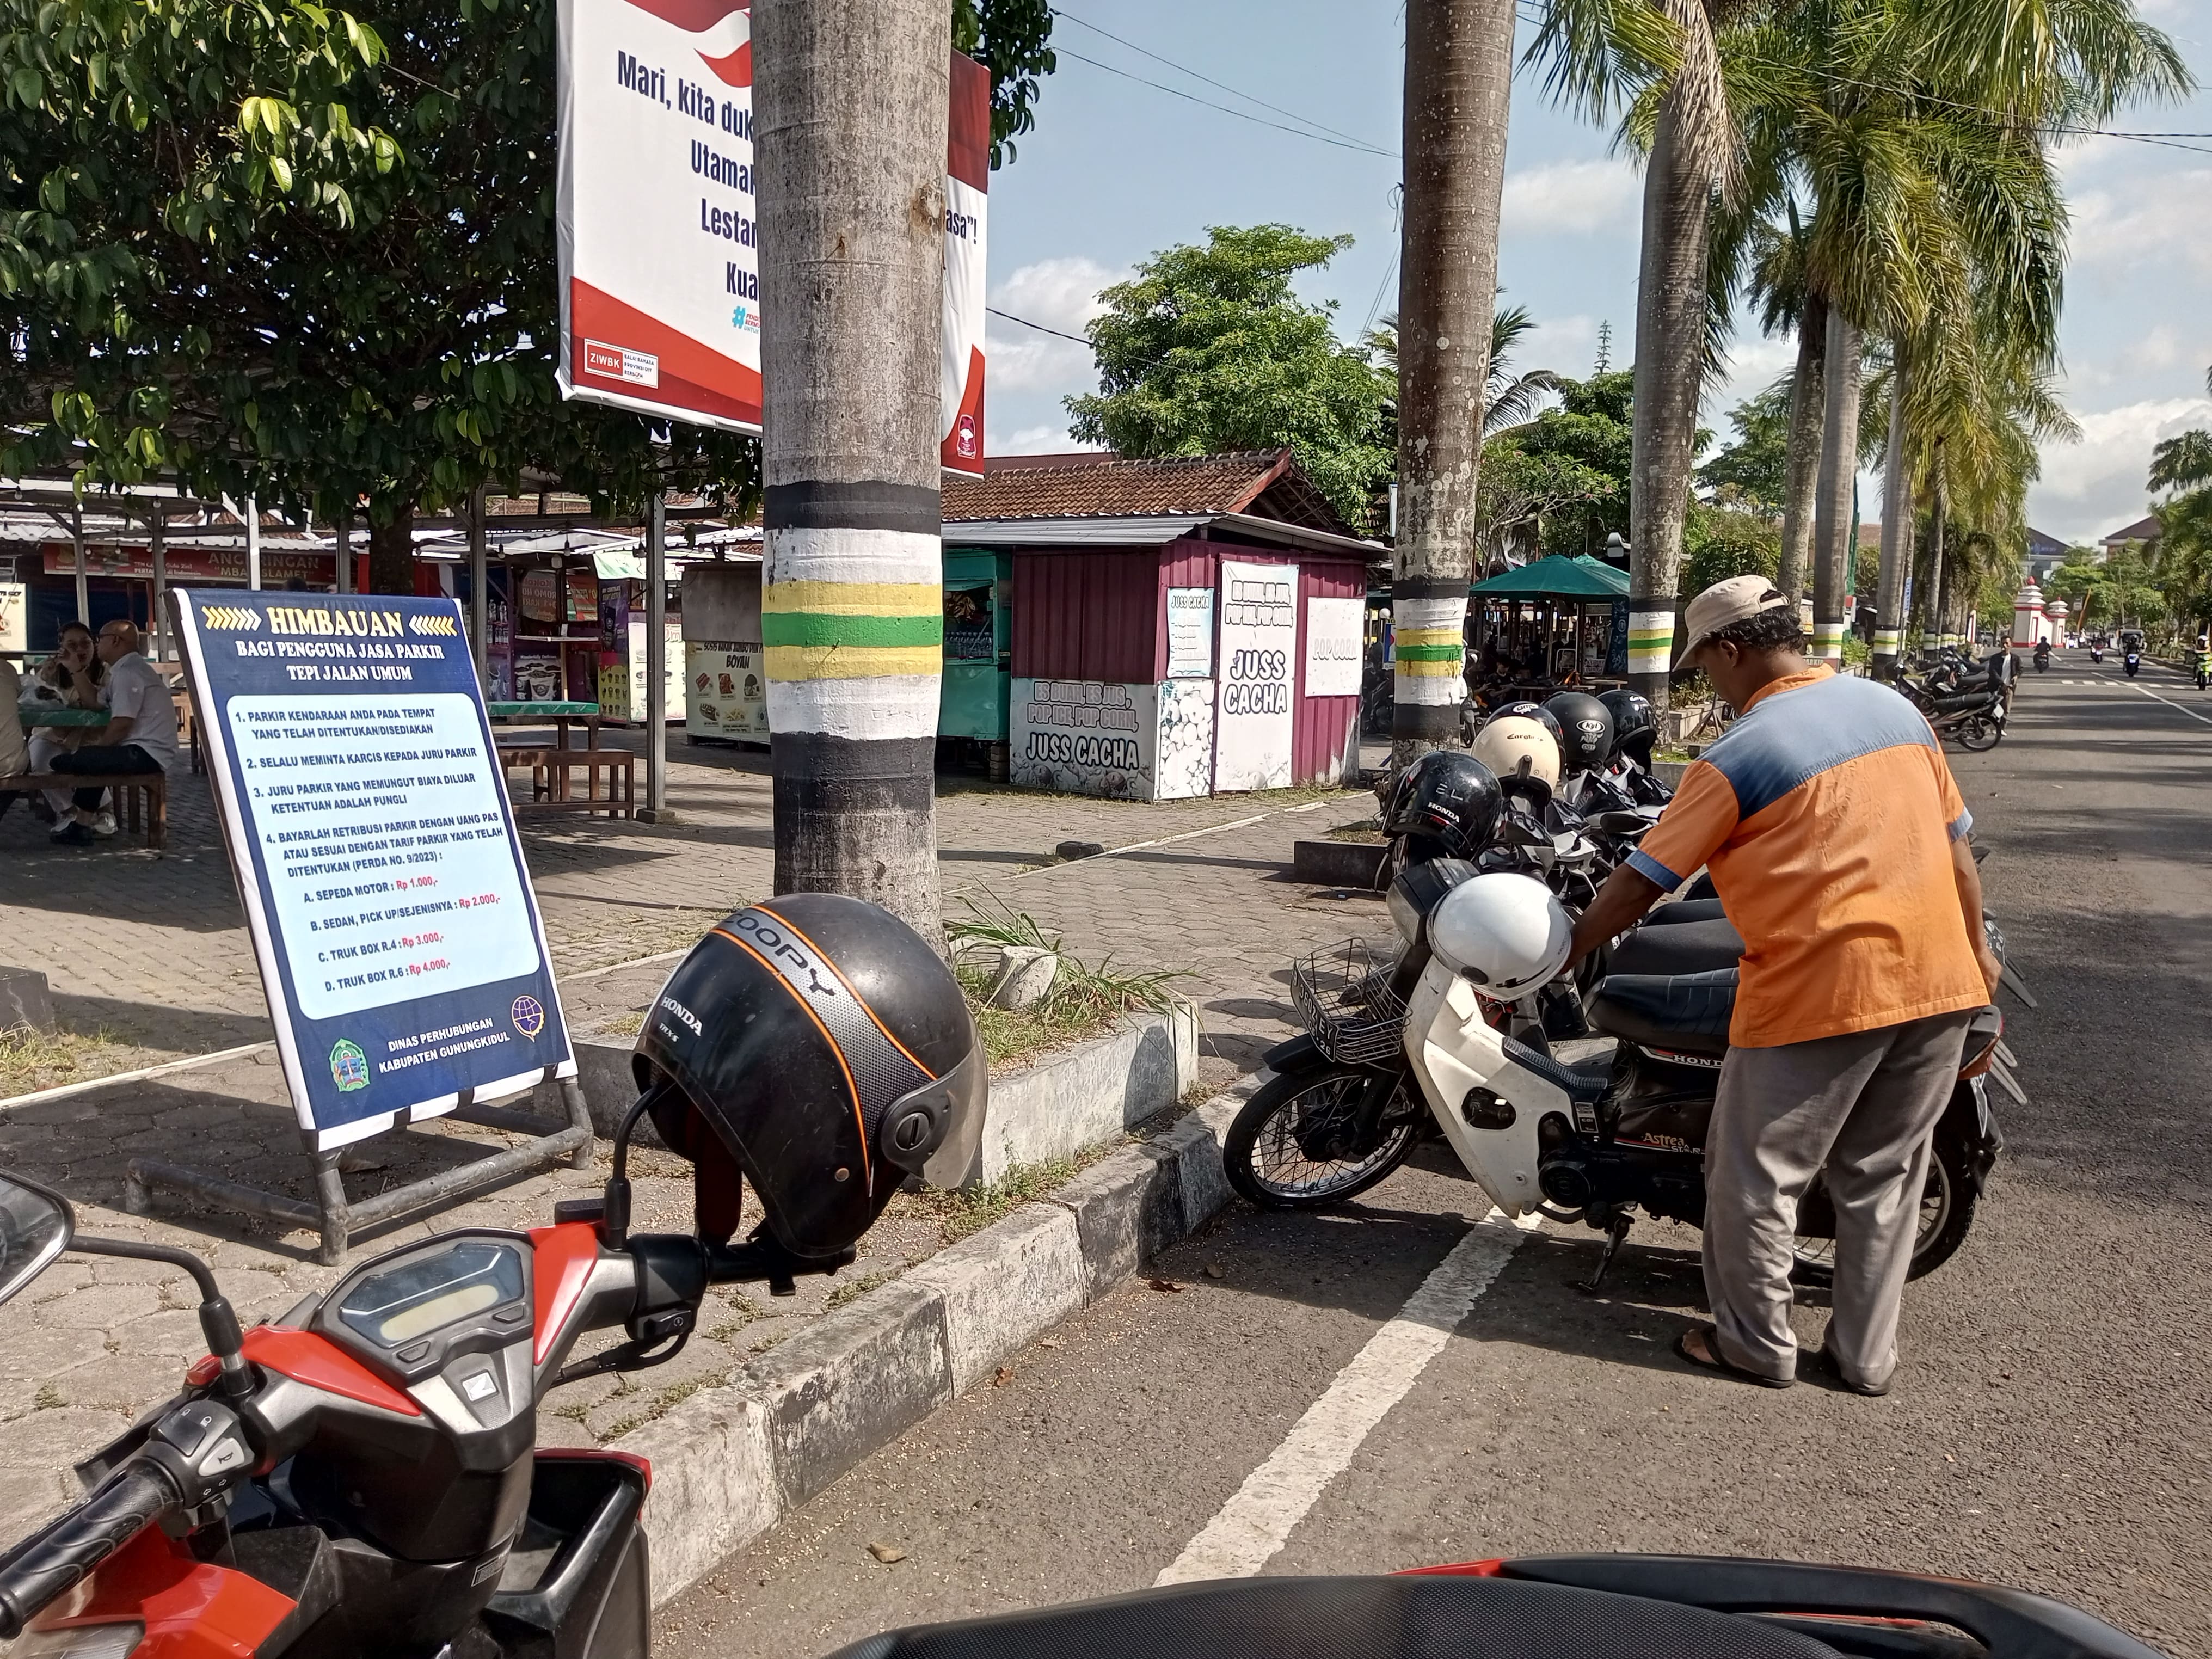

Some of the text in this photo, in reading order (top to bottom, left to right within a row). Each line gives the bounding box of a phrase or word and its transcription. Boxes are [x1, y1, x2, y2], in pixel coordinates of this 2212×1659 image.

[618, 50, 671, 110] Mari,
[679, 77, 714, 126] kita
[589, 353, 621, 369] ZIWBK
[1171, 595, 1209, 609] JUSS CACHA
[266, 607, 404, 637] HIMBAUAN
[235, 641, 445, 659] BAGI PENGGUNA JASA PARKIR
[1313, 638, 1357, 660] POP CORN
[286, 665, 413, 680] TEPI JALAN UMUM
[1230, 649, 1286, 680] JUSS
[1034, 681, 1050, 702] ES
[1085, 684, 1103, 705] ES
[1224, 683, 1287, 715] CACHA
[236, 708, 435, 722] 1. PARKIR KENDARAAN ANDA PADA TEMPAT
[1028, 703, 1052, 724] POP
[1074, 706, 1100, 728] POP
[251, 724, 433, 739] YANG TELAH DITENTUKAN/DISEDIAKAN
[247, 747, 477, 769] 2. SELALU MEMINTA KARCIS KEPADA JURU PARKIR
[1026, 732, 1139, 771] JUSS CACHA
[253, 773, 476, 798] 3. JURU PARKIR YANG MEMUNGUT BIAYA DILUAR
[271, 794, 407, 814] KETENTUAN ADALAH PUNGLI
[1428, 801, 1460, 823] HONDA
[266, 812, 499, 844] 4. BAYARLAH RETRIBUSI PARKIR DENGAN UANG PAS
[284, 827, 503, 861] ATAU SESUAI DENGAN TARIF PARKIR YANG TELAH
[287, 851, 438, 877] DITENTUKAN (PERDA NO. 9/2023)
[304, 876, 438, 903] A. SEPEDA MOTOR Rp 1.000,-
[310, 893, 501, 931] B. SEDAN, PICK UP/SEJENISNYA Rp 2.000,-
[318, 932, 444, 962] C. TRUK BOX R.4 Rp 3.000,-
[325, 958, 451, 992] D. TRUK BOX R.6 Rp 4.000,-
[660, 996, 703, 1036] HONDA
[388, 1017, 494, 1053] DINAS PERHUBUNGAN
[378, 1031, 511, 1073] KABUPATEN GUNUNGKIDUL
[1643, 1132, 1685, 1148] Astrea
[1670, 1145, 1701, 1154] STAR
